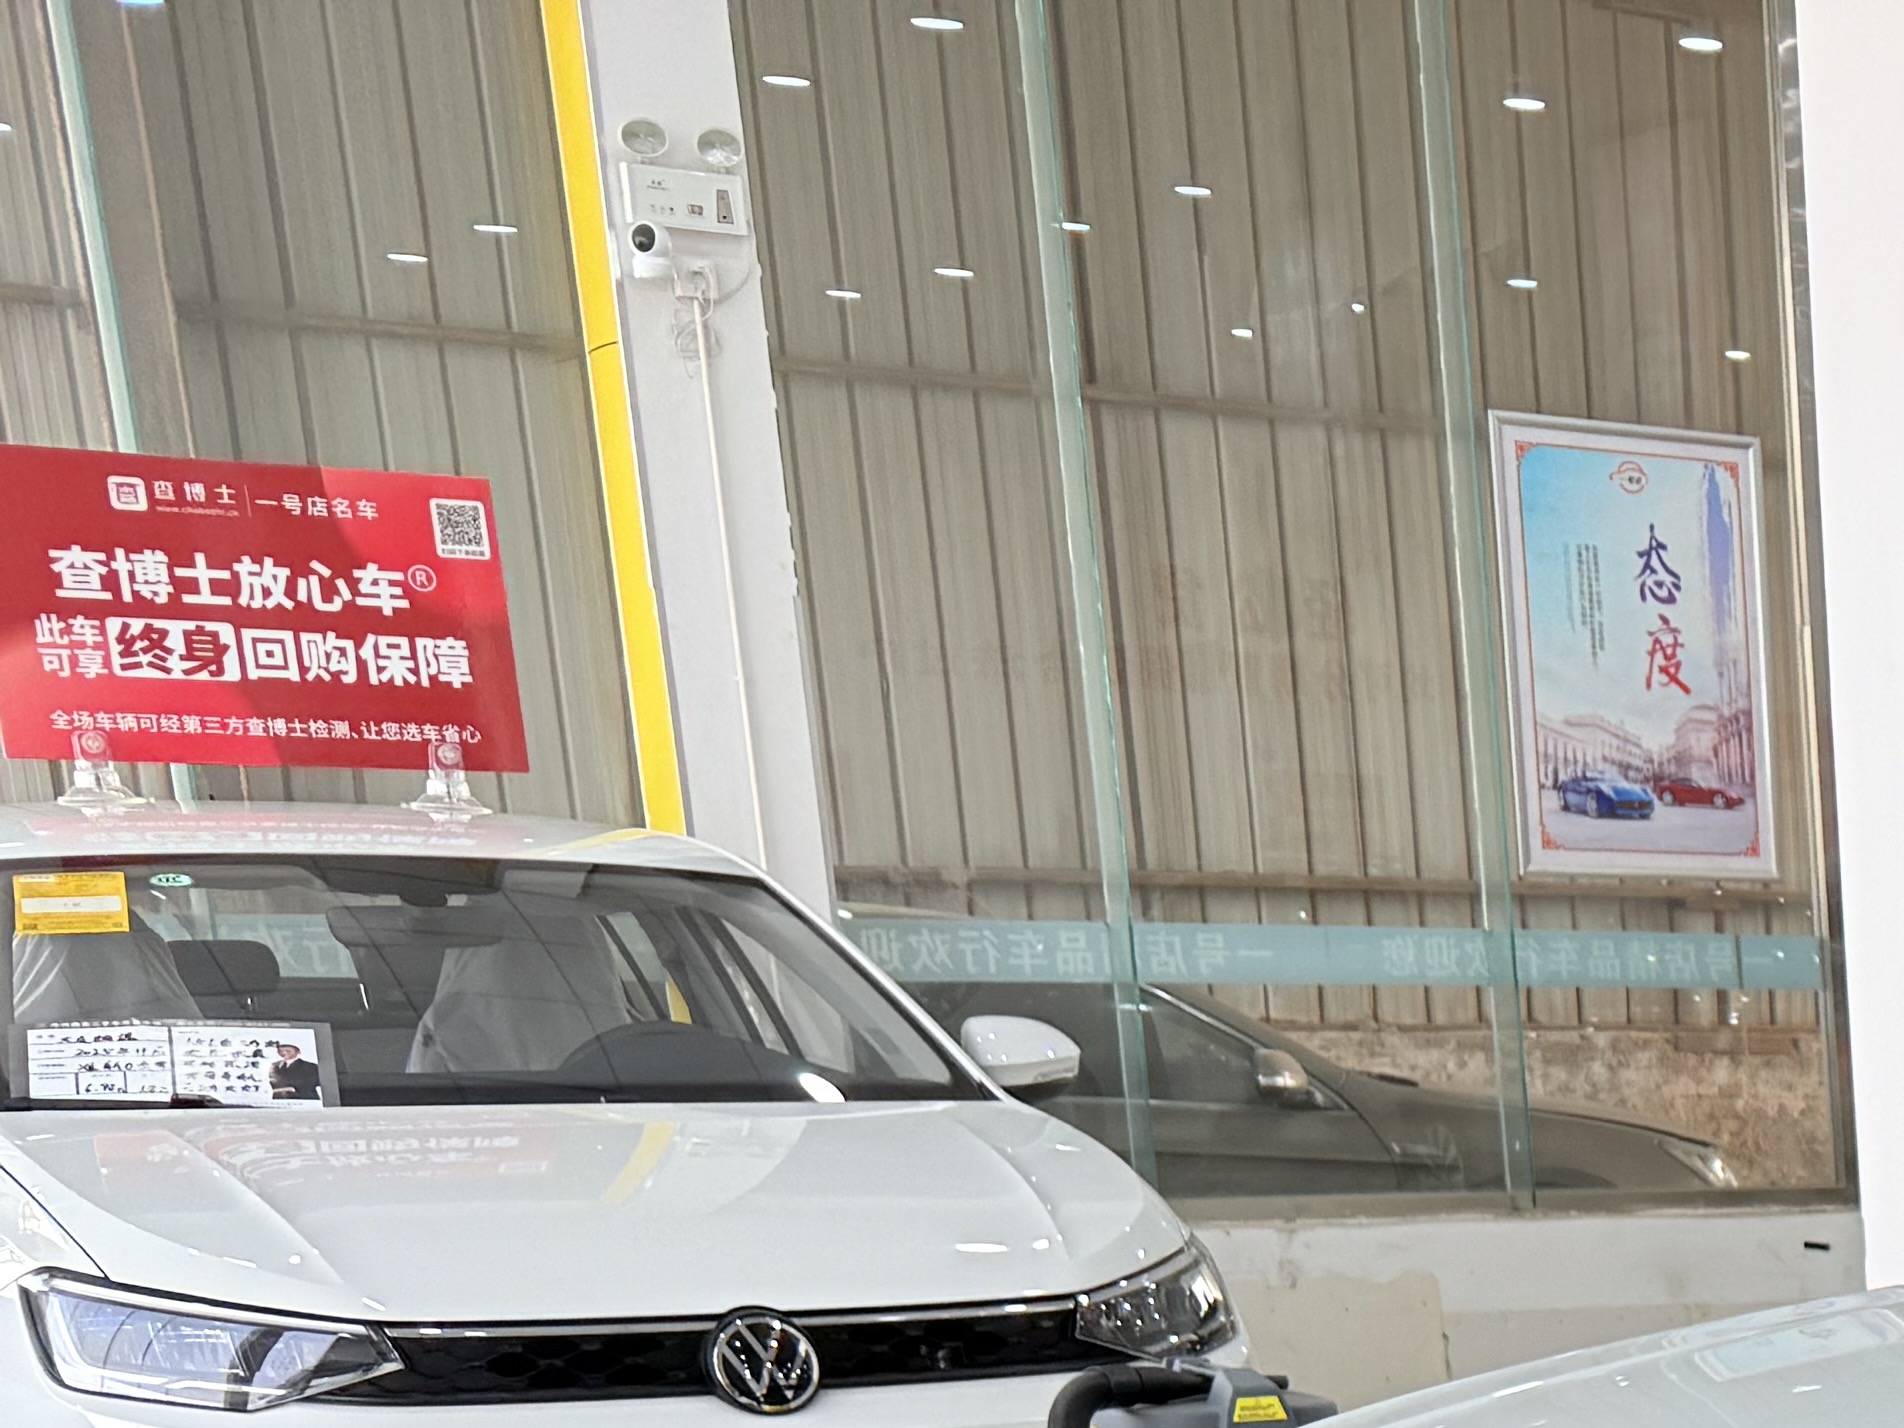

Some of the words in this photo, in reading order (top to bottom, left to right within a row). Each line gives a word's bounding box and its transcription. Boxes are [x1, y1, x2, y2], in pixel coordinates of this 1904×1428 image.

[153, 480, 237, 506] 查博士
[255, 494, 379, 522] 一号店名车
[34, 613, 104, 646] 此车
[1635, 522, 1692, 696] 态度
[41, 647, 109, 679] 可享
[113, 620, 474, 689] 终身回购保障
